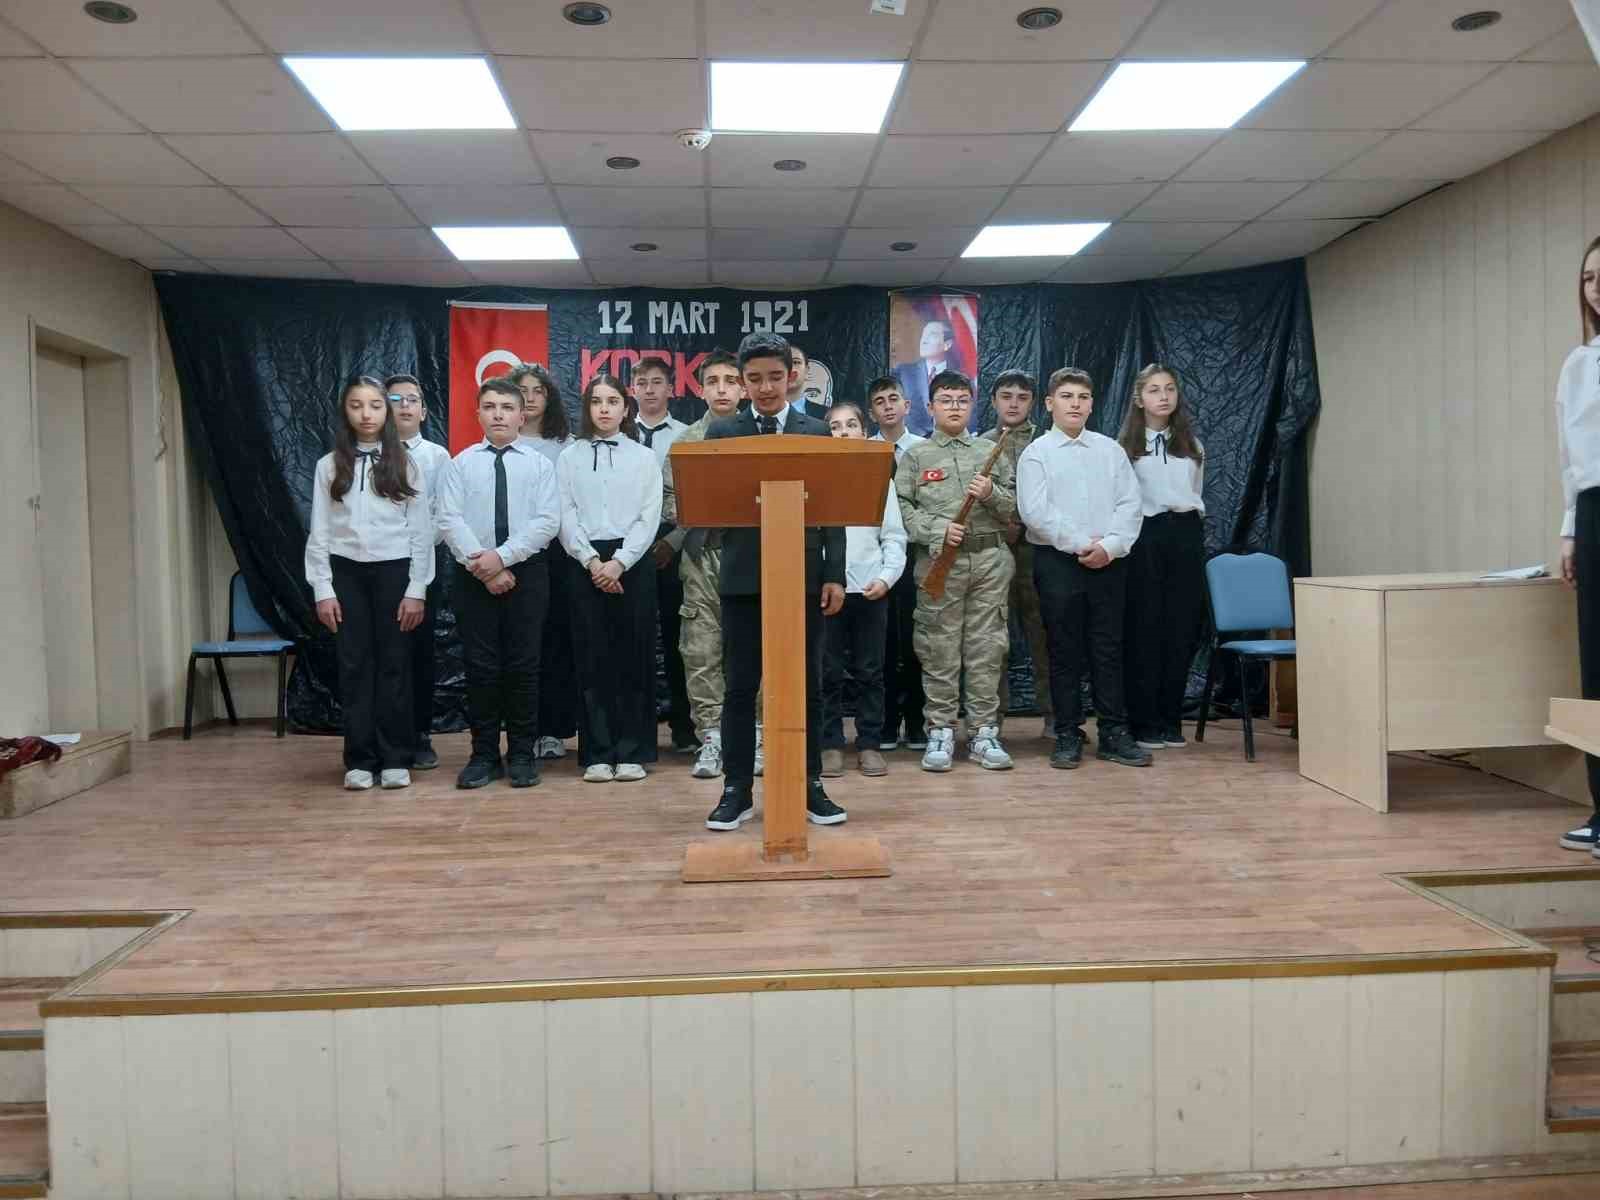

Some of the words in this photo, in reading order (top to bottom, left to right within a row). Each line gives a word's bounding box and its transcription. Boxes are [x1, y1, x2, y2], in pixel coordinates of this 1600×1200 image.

[598, 300, 633, 334] 12
[649, 301, 720, 334] MART
[740, 300, 809, 334] 1921
